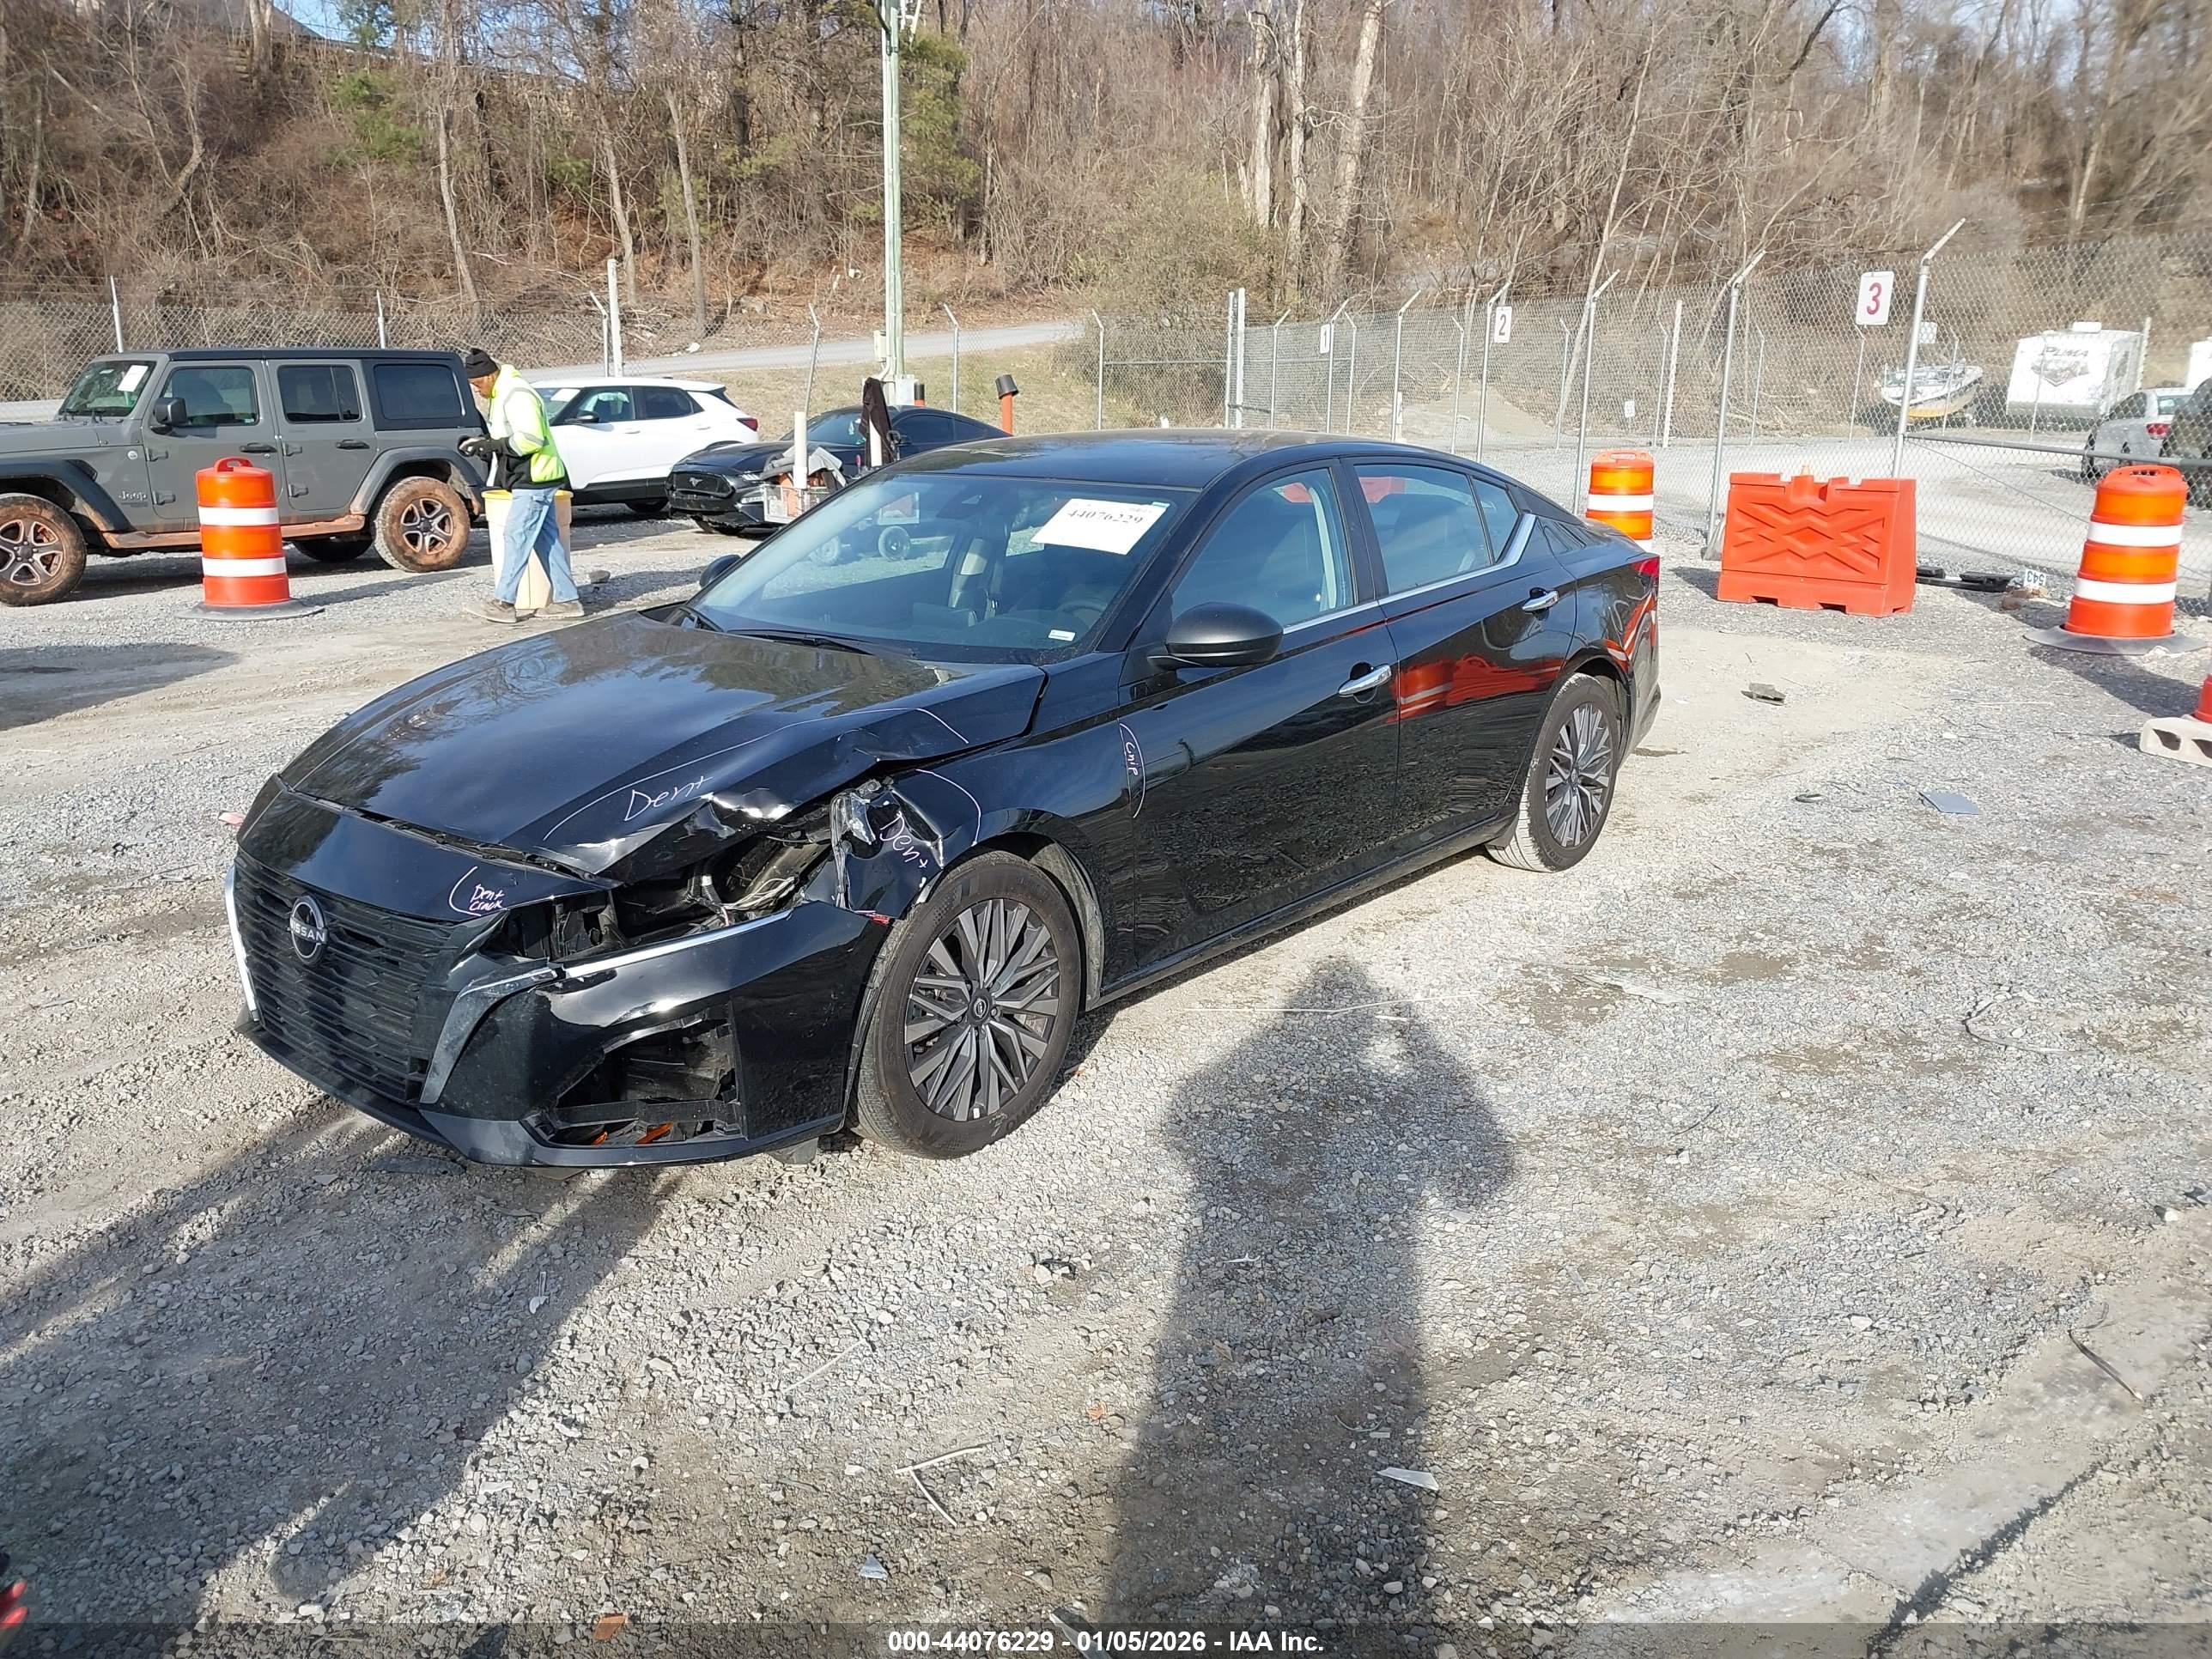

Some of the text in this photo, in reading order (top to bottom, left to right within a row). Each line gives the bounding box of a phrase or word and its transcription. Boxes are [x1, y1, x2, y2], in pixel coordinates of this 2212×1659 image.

[1866, 282, 1882, 315] 3
[1498, 313, 1507, 336] 2
[1066, 508, 1144, 524] 44076229
[623, 775, 714, 822] Dent
